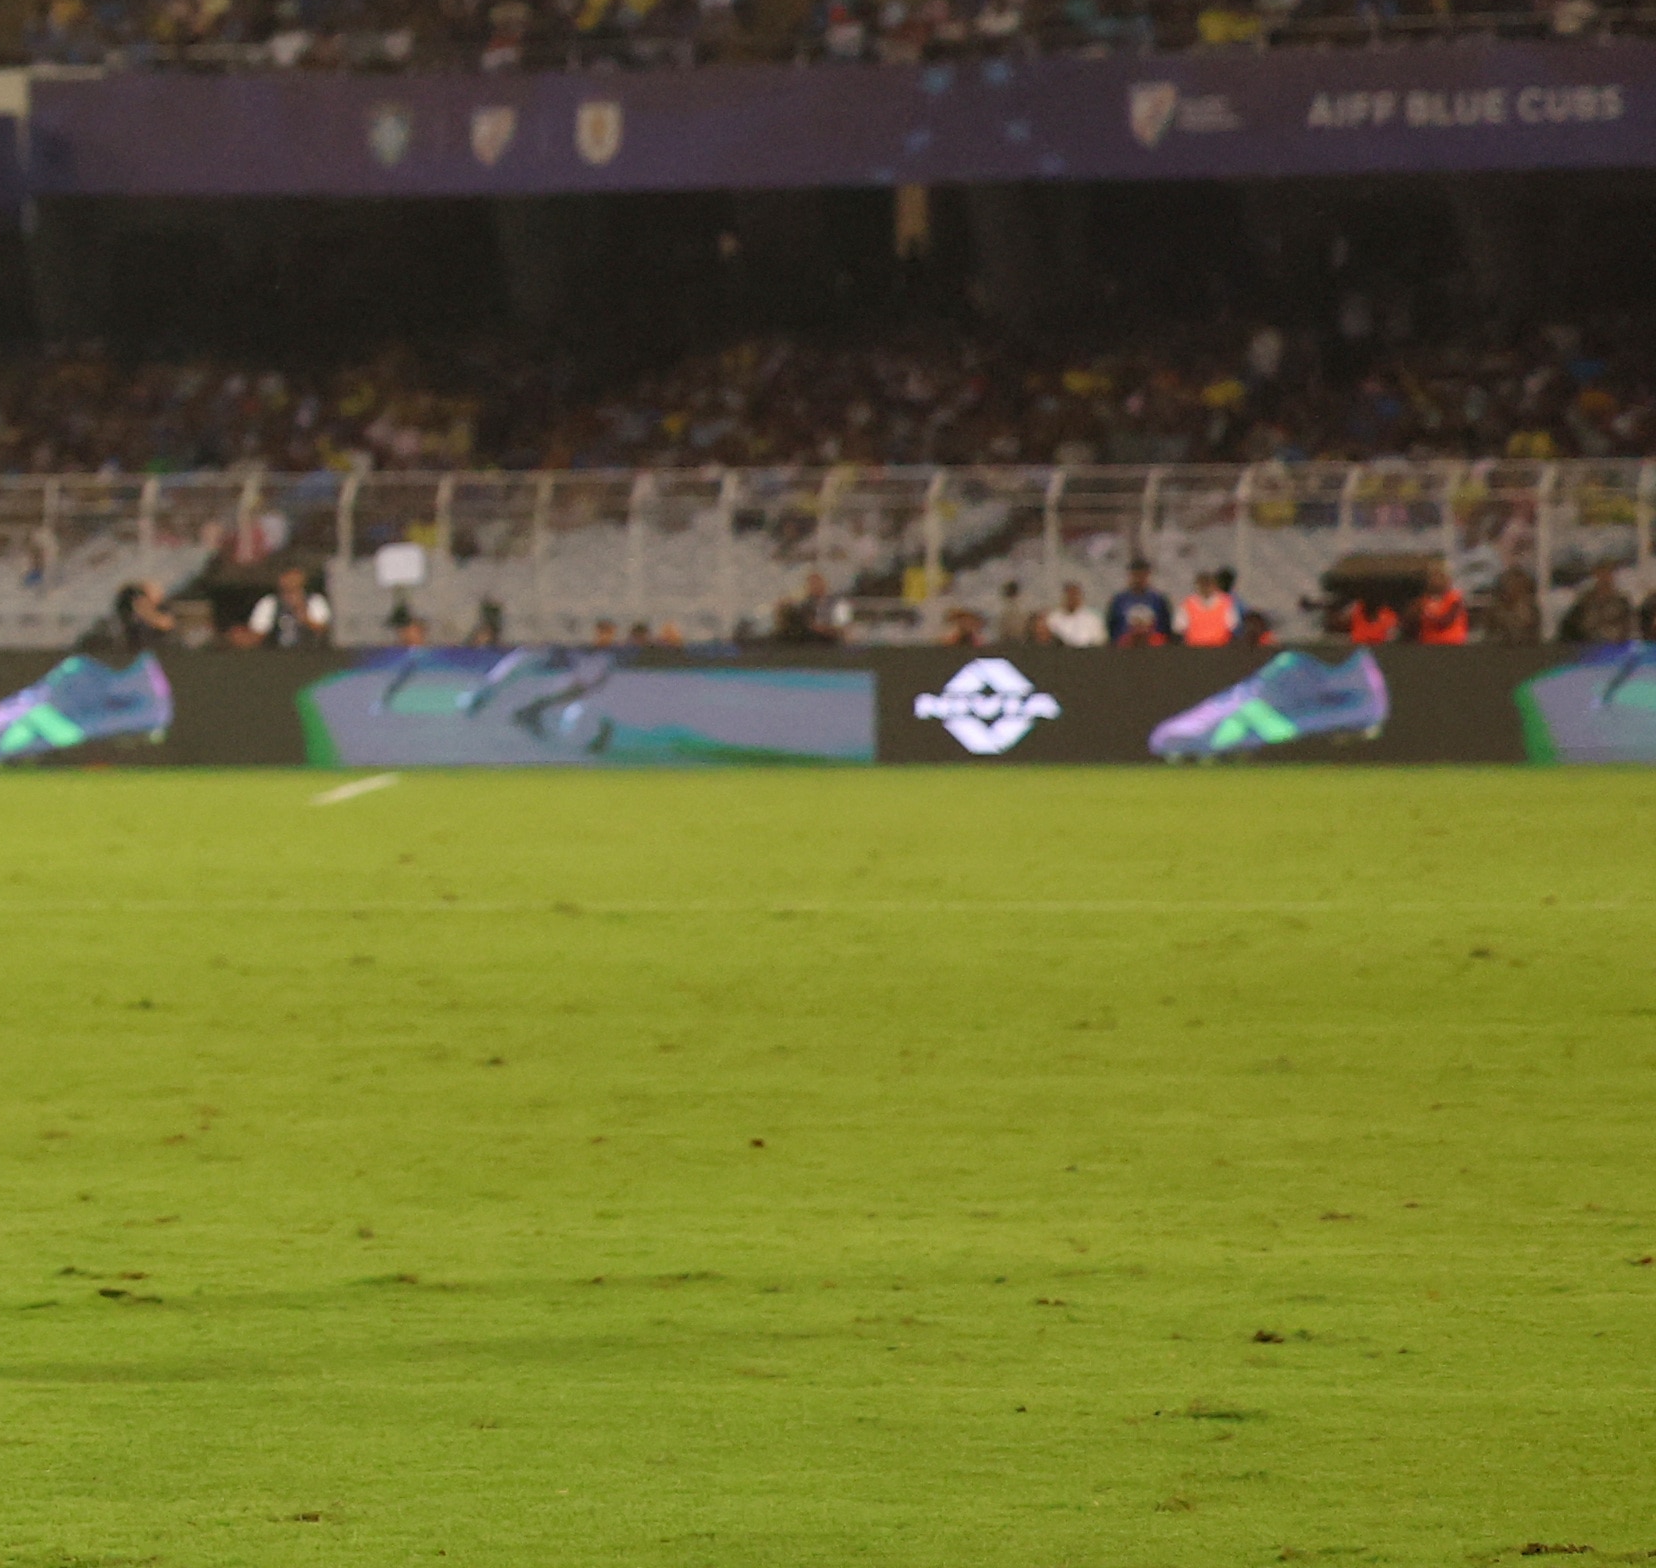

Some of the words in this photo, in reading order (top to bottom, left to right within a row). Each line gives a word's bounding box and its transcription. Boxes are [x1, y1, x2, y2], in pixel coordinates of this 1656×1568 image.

[1307, 90, 1396, 127] AIFF
[1405, 88, 1505, 127] BLUE
[1516, 84, 1624, 123] CUBS
[914, 692, 1062, 720] NIVIA
